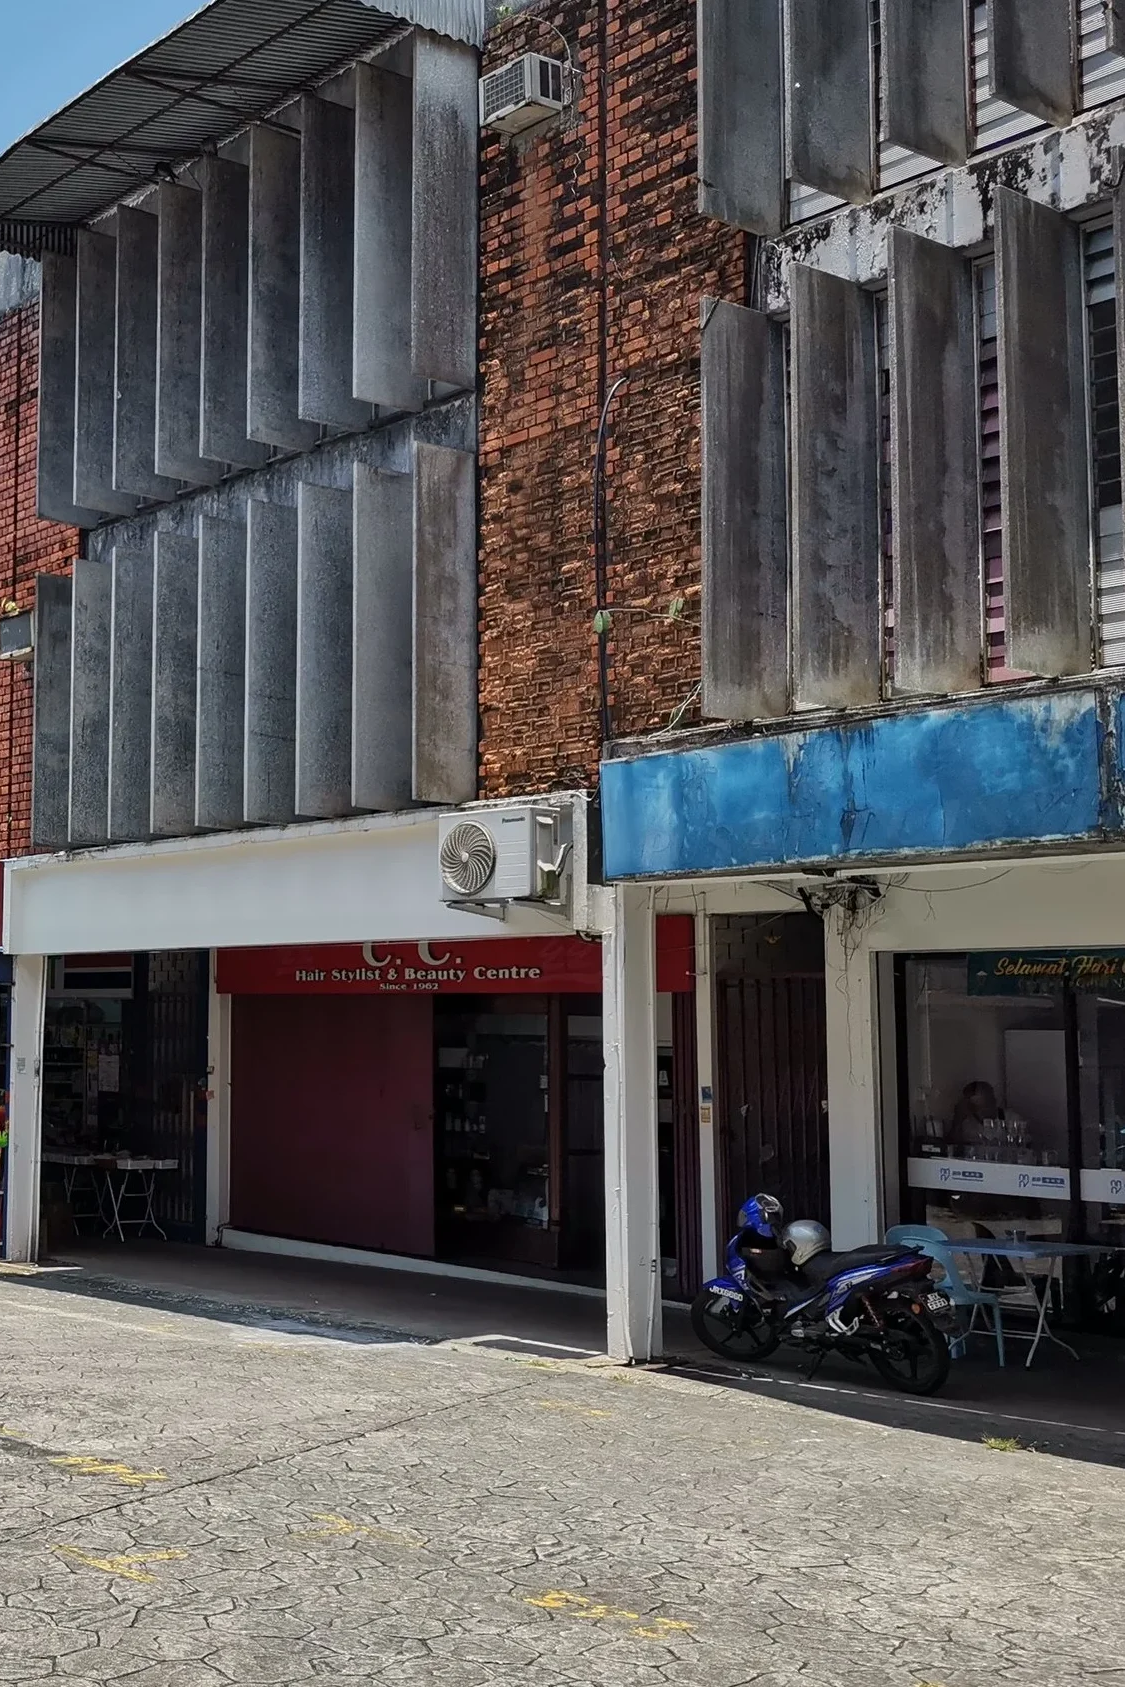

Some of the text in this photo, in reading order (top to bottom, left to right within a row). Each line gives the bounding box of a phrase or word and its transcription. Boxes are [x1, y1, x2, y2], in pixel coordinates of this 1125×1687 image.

[993, 956, 1070, 976] Selamat
[1071, 955, 1119, 975] Hari
[295, 966, 542, 983] Hair Stylist & Beauty Centre
[379, 982, 440, 990] Since 1962
